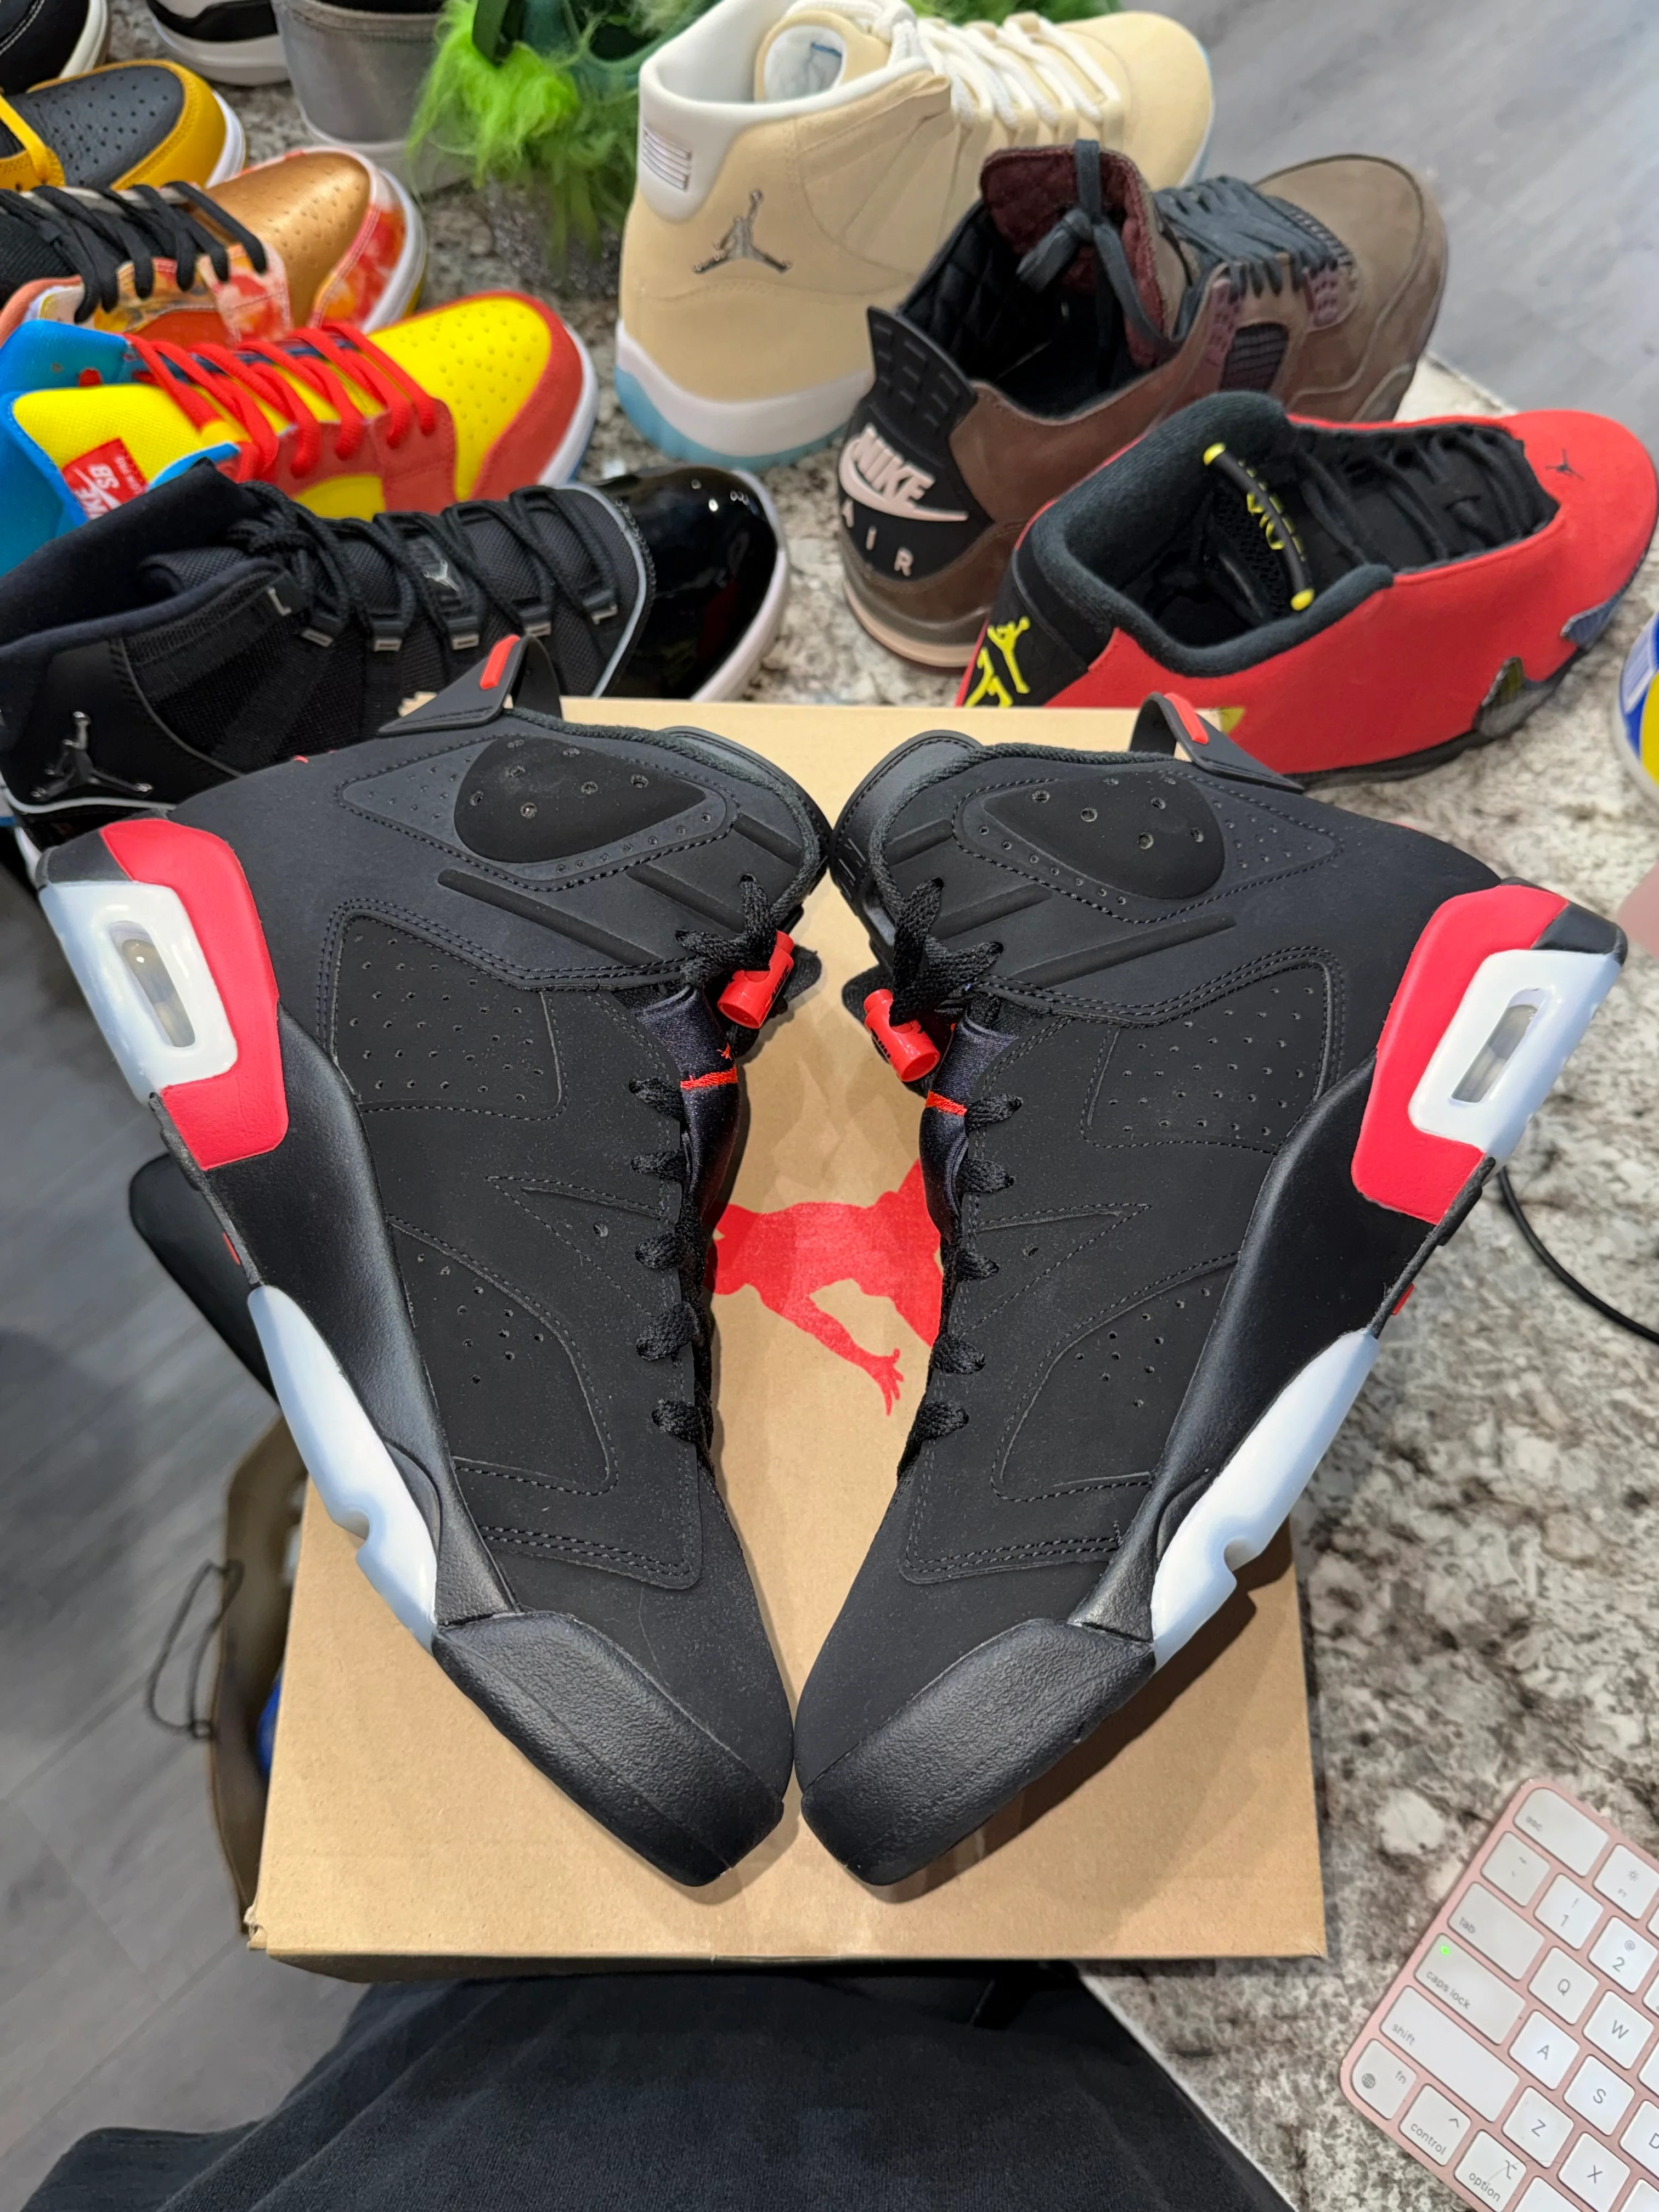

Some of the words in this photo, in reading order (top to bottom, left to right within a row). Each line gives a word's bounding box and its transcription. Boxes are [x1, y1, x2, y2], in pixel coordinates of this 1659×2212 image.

[851, 422, 936, 507] NIKE
[88, 464, 120, 489] SB
[1525, 1815, 1543, 1832] esc
[1459, 1916, 1476, 1934] tab
[1560, 1914, 1569, 1927] 1
[1624, 1939, 1635, 1951] @
[1612, 1956, 1625, 1972] 2
[1426, 1971, 1449, 1993] caps
[1449, 1988, 1470, 2009] lock
[1558, 1978, 1571, 1996] Q
[1391, 2023, 1415, 2046] shift
[1611, 2019, 1629, 2040] W
[1537, 2044, 1550, 2061] A
[1395, 2070, 1407, 2085] fn
[1593, 2088, 1607, 2104] S
[1531, 2119, 1547, 2137] Z
[1410, 2123, 1447, 2155] control
[1587, 2164, 1603, 2184] X
[1468, 2172, 1502, 2202] option
